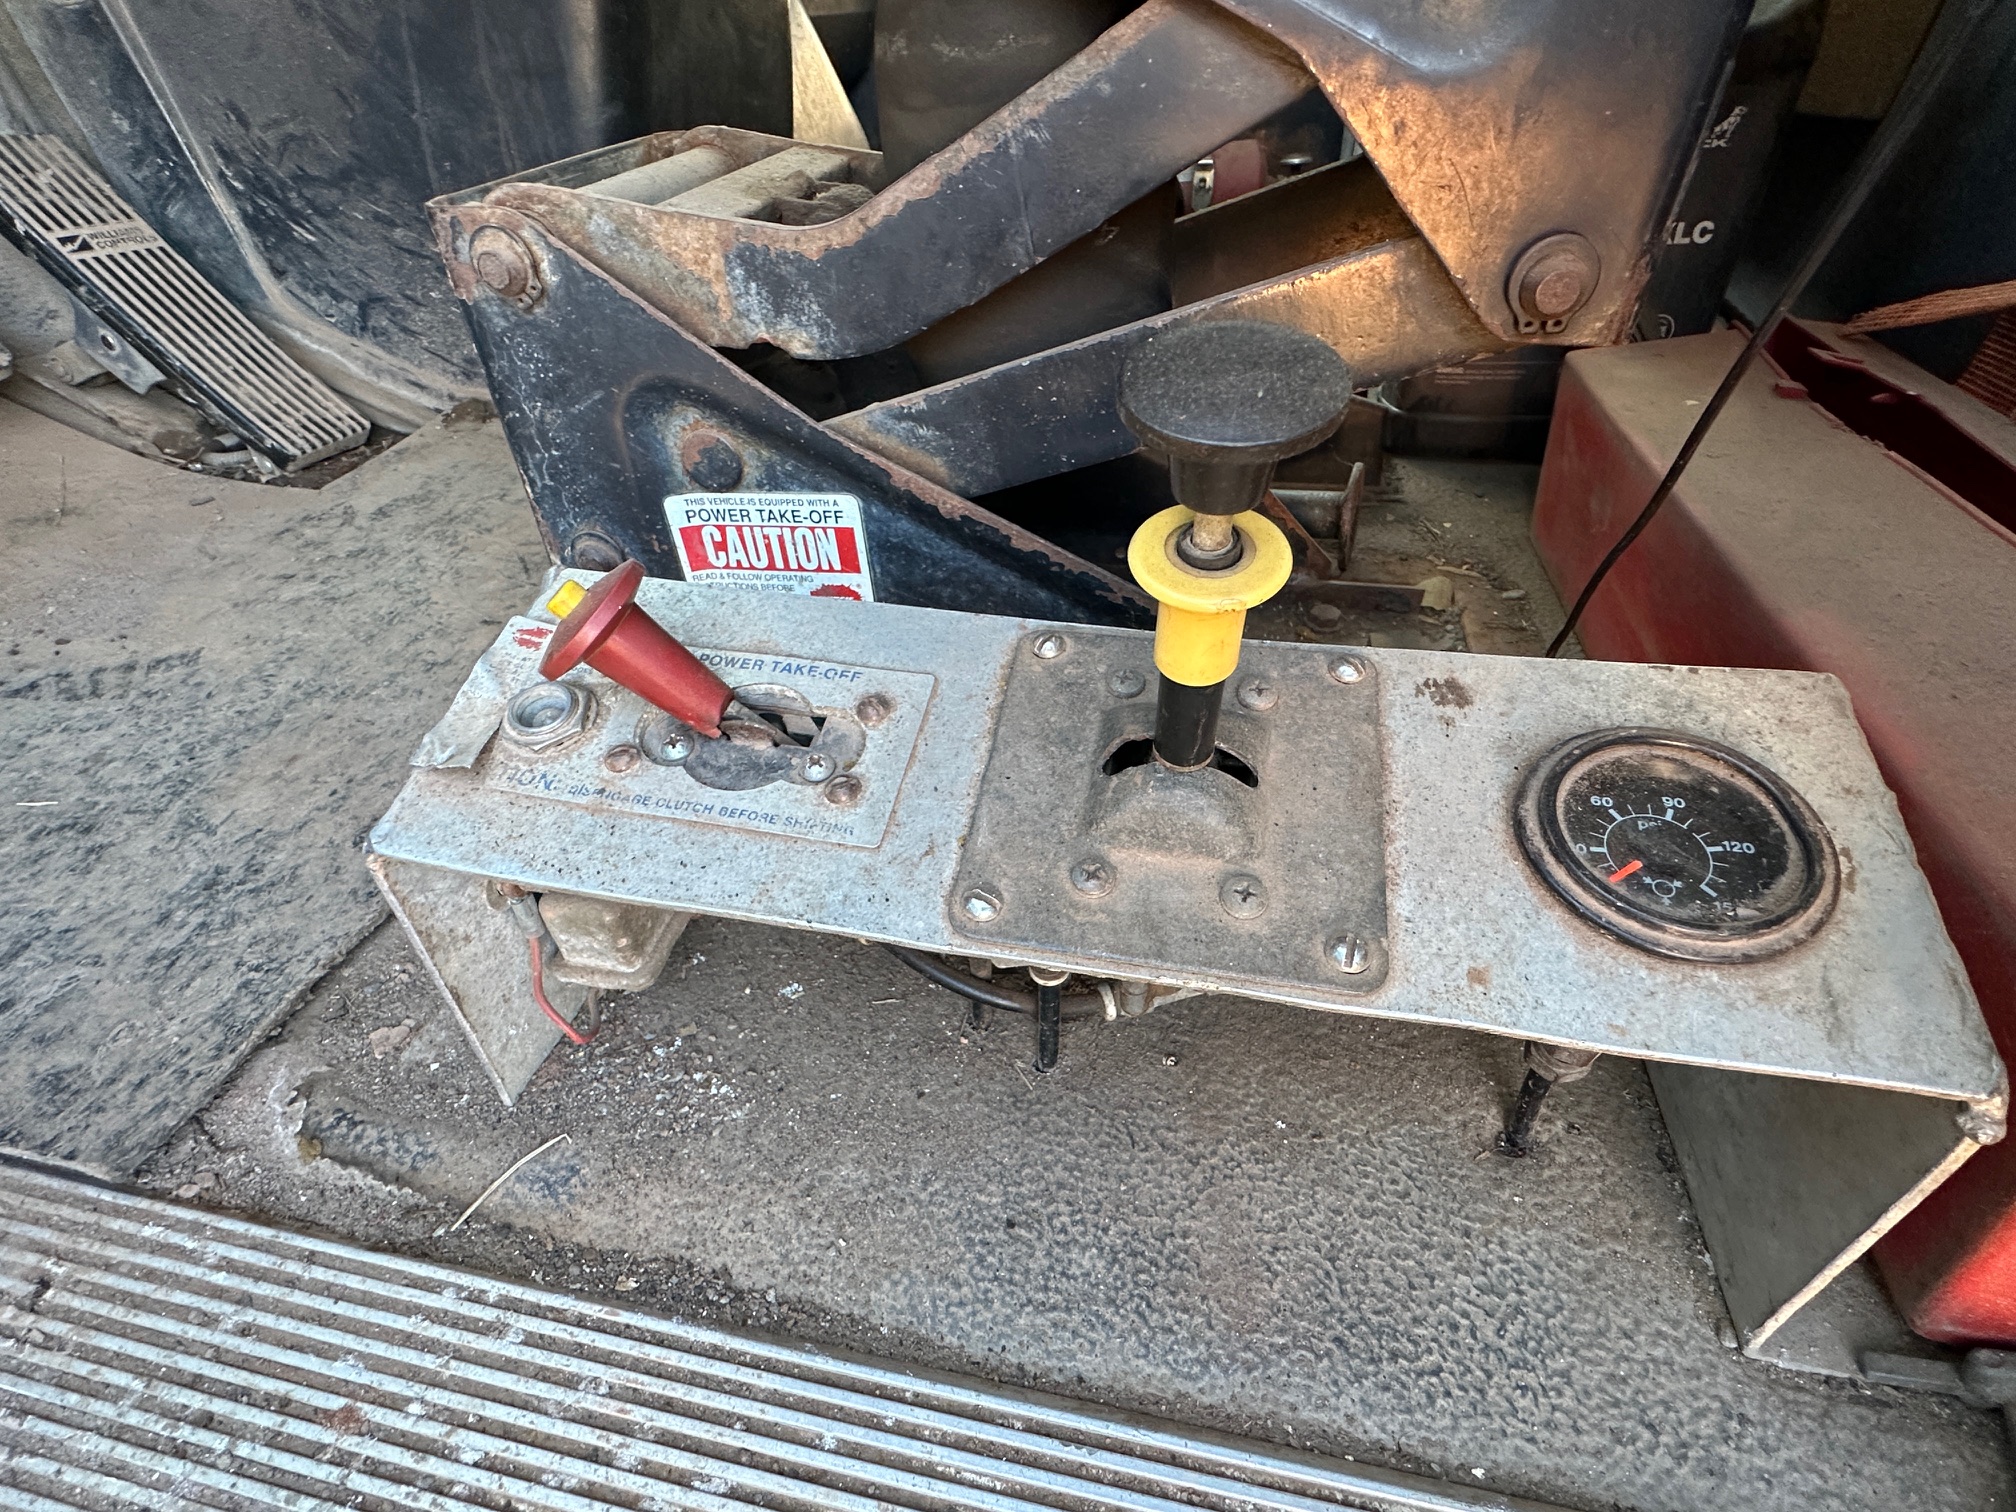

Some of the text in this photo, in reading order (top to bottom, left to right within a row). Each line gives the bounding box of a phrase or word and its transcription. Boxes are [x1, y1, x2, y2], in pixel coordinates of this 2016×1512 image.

[86, 227, 144, 241] WILLIAMS
[96, 235, 159, 250] CONTROLS
[683, 497, 840, 507] THIS VEHICLE IS EQUIPPED WITH A
[685, 508, 844, 525] POWER TAKE-OFF
[701, 525, 842, 571] CAUTION
[692, 572, 718, 582] READ
[726, 572, 763, 582] FOLLOW
[764, 573, 814, 583] OPERATING
[760, 583, 796, 592] BEFORE
[699, 653, 864, 682] POWER TAKE-OFF
[1590, 795, 1614, 807] 60
[1661, 796, 1686, 808] 90
[655, 797, 716, 815] CLUTCH
[718, 806, 780, 825] BEFORE
[782, 816, 856, 836] SHIFTING
[1721, 840, 1756, 854] 120
